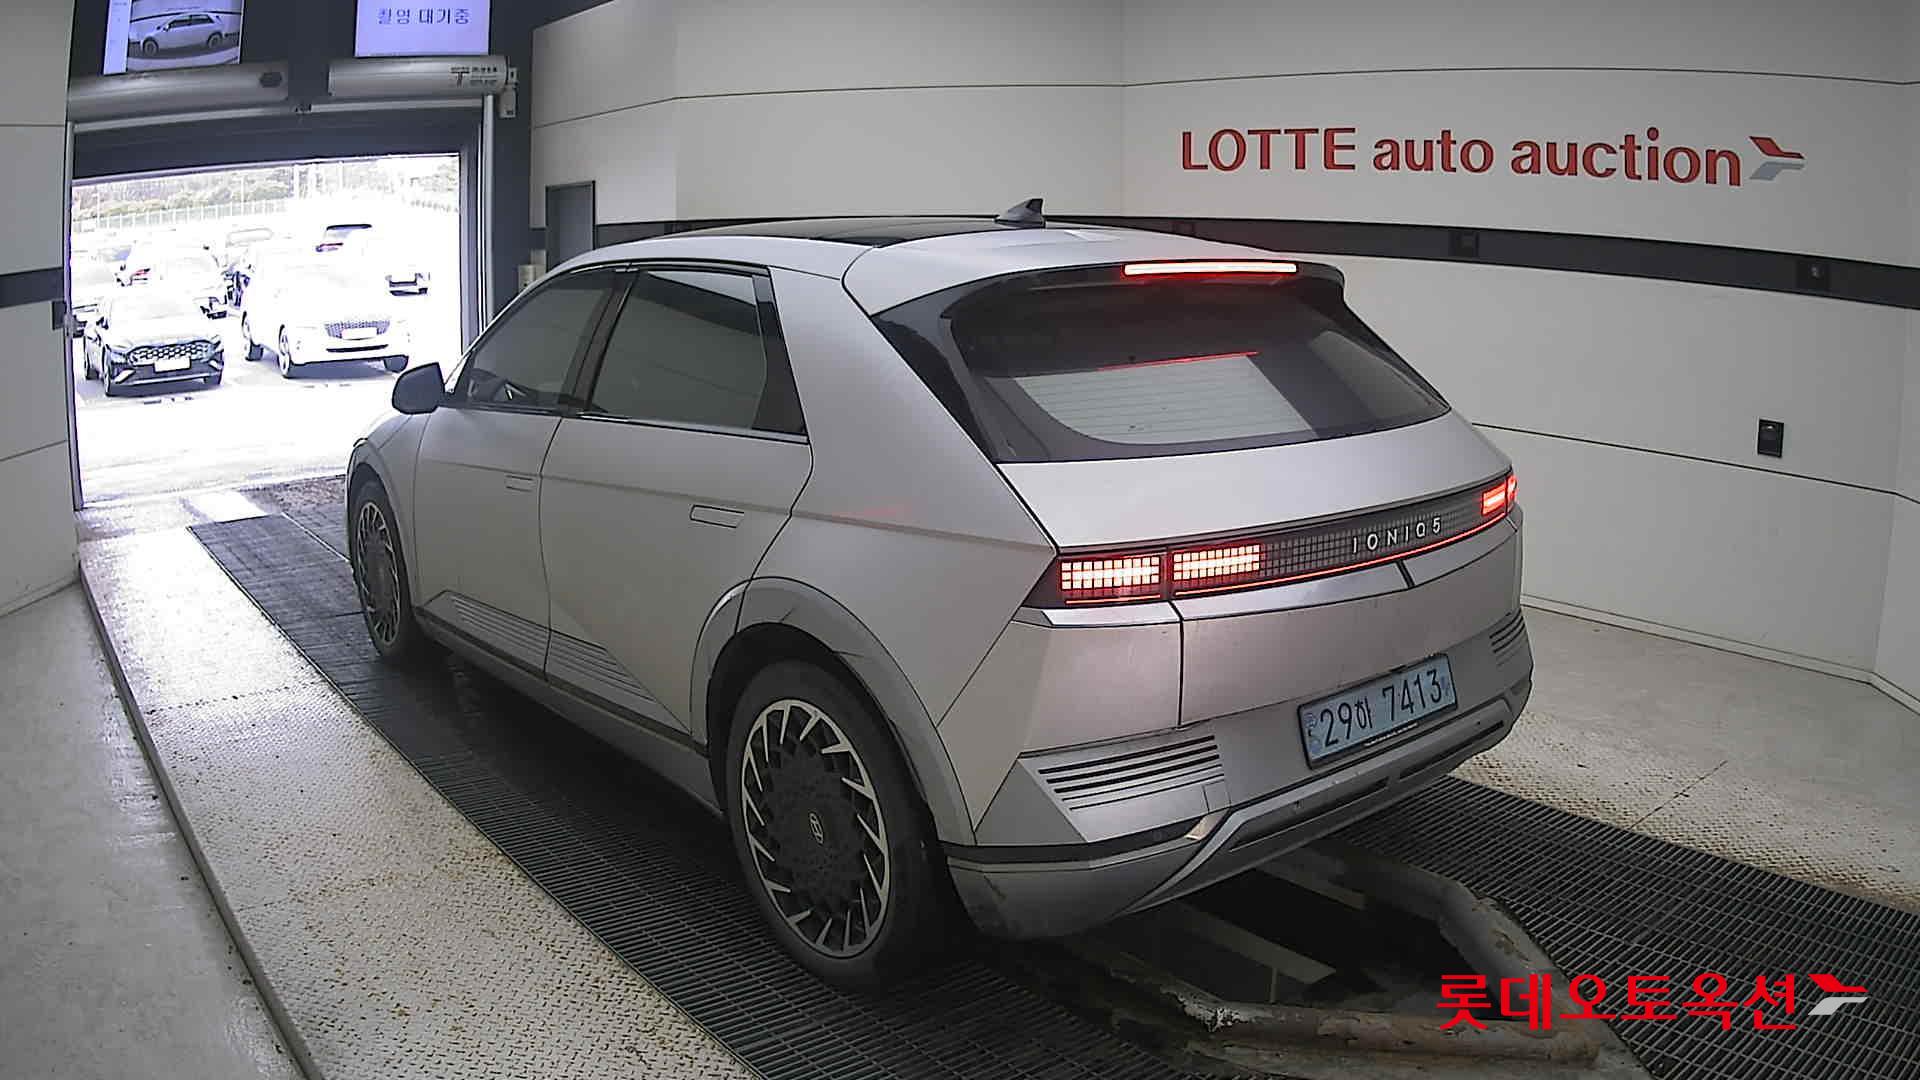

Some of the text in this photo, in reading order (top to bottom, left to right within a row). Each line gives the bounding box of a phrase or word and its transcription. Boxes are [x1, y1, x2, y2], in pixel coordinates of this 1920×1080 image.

[419, 8, 470, 24] 대기중
[1182, 127, 1742, 186] LOTTE auto auction
[1320, 669, 1442, 747] 29하 7413
